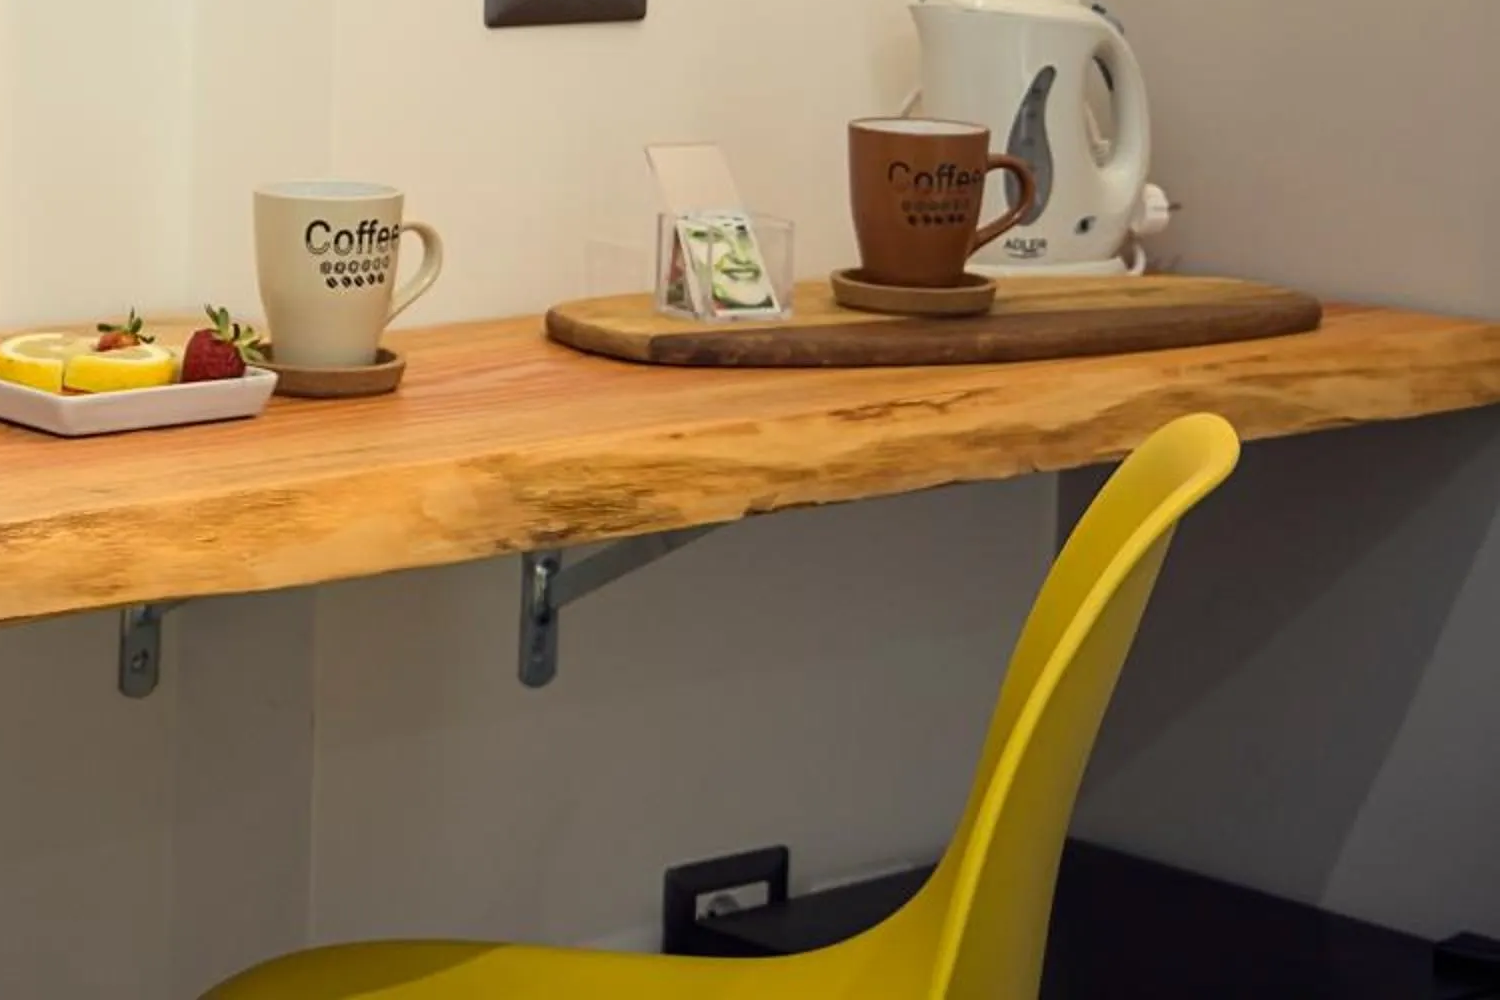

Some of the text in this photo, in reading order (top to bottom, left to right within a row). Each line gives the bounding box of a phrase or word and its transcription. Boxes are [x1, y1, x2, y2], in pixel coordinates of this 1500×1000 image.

[887, 161, 983, 194] Coffee
[304, 219, 399, 256] Coffee
[1003, 238, 1048, 250] ADLER
